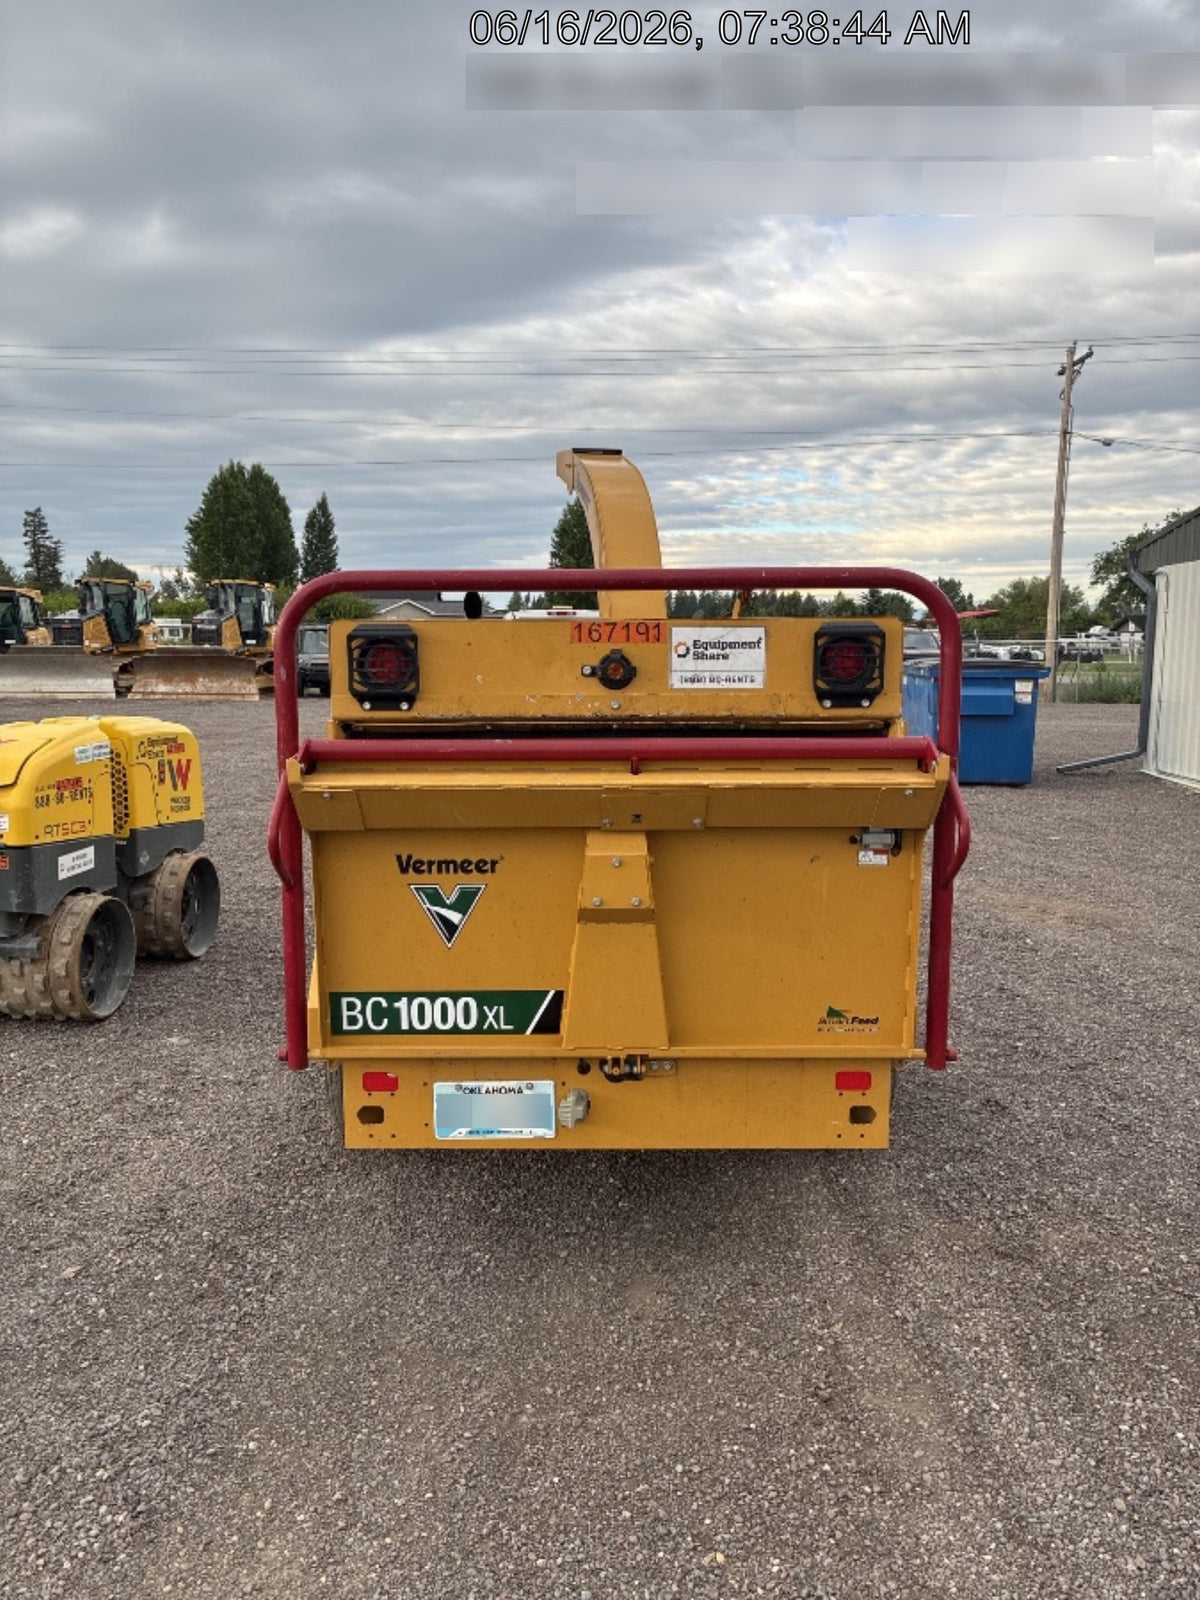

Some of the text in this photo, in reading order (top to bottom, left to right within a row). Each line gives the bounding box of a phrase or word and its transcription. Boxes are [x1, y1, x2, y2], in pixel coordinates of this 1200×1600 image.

[573, 622, 662, 642] 167191
[692, 636, 763, 651] Equipment
[692, 651, 730, 660] Share
[396, 854, 500, 875] Vermeer
[462, 1085, 524, 1095] OKLAHOMA
